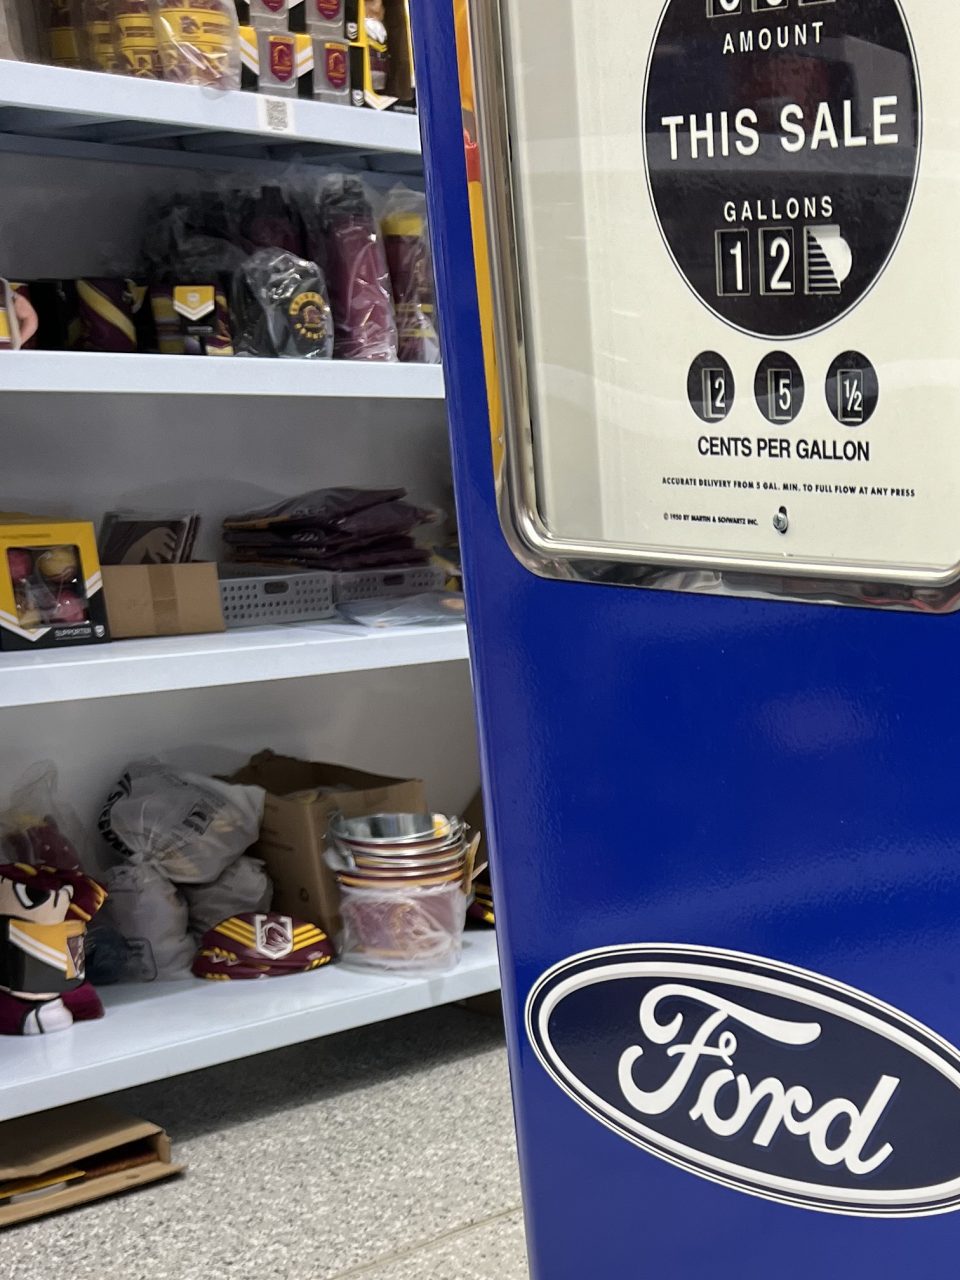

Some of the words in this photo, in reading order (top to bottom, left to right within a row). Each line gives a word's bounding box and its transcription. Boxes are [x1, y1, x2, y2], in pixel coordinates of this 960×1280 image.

[722, 21, 824, 55] AMOUNT
[661, 108, 760, 160] THIS
[780, 95, 899, 153] SALE
[723, 195, 833, 222] GALLONS
[715, 377, 726, 408] 2
[779, 379, 791, 410] 5
[698, 436, 751, 457] CENTS
[757, 437, 791, 459] PER
[796, 439, 870, 461] GALLON
[662, 477, 697, 486] ACCURATE
[699, 478, 731, 488] DELIVERY
[733, 480, 754, 489] FROM
[803, 484, 813, 492] TO
[815, 484, 833, 493] FULL
[835, 485, 856, 494] FLOW
[859, 486, 869, 495] AT
[871, 487, 888, 496] ANY
[890, 488, 915, 497] PRESS
[691, 514, 711, 523] MARTIN
[618, 983, 901, 1176] Ford
